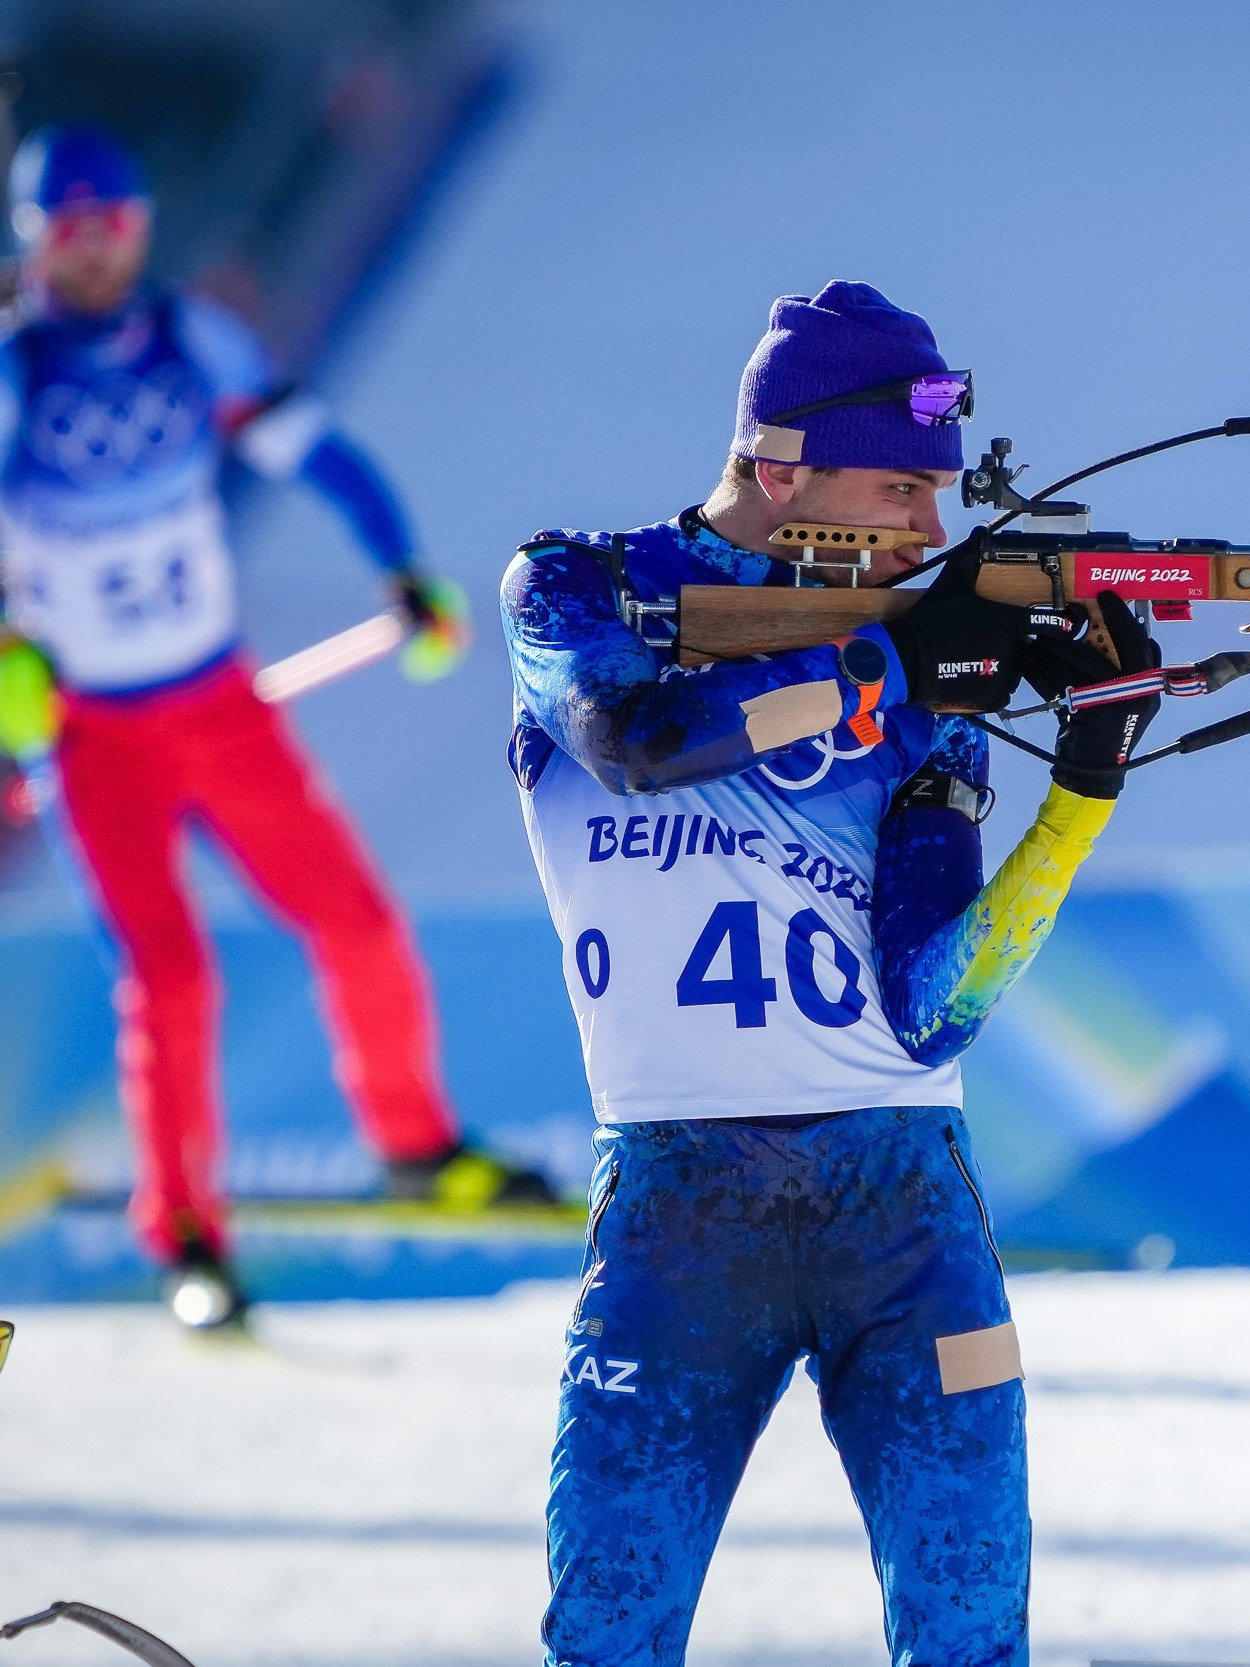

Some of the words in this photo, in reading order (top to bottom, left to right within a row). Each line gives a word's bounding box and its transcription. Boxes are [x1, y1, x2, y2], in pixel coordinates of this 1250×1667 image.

[1090, 567, 1147, 585] BEIJING
[1150, 568, 1194, 582] 2022
[1188, 588, 1203, 596] RCS
[938, 658, 1000, 676] KINETIXX
[586, 814, 766, 873] BEIJING
[676, 900, 868, 1029] 40
